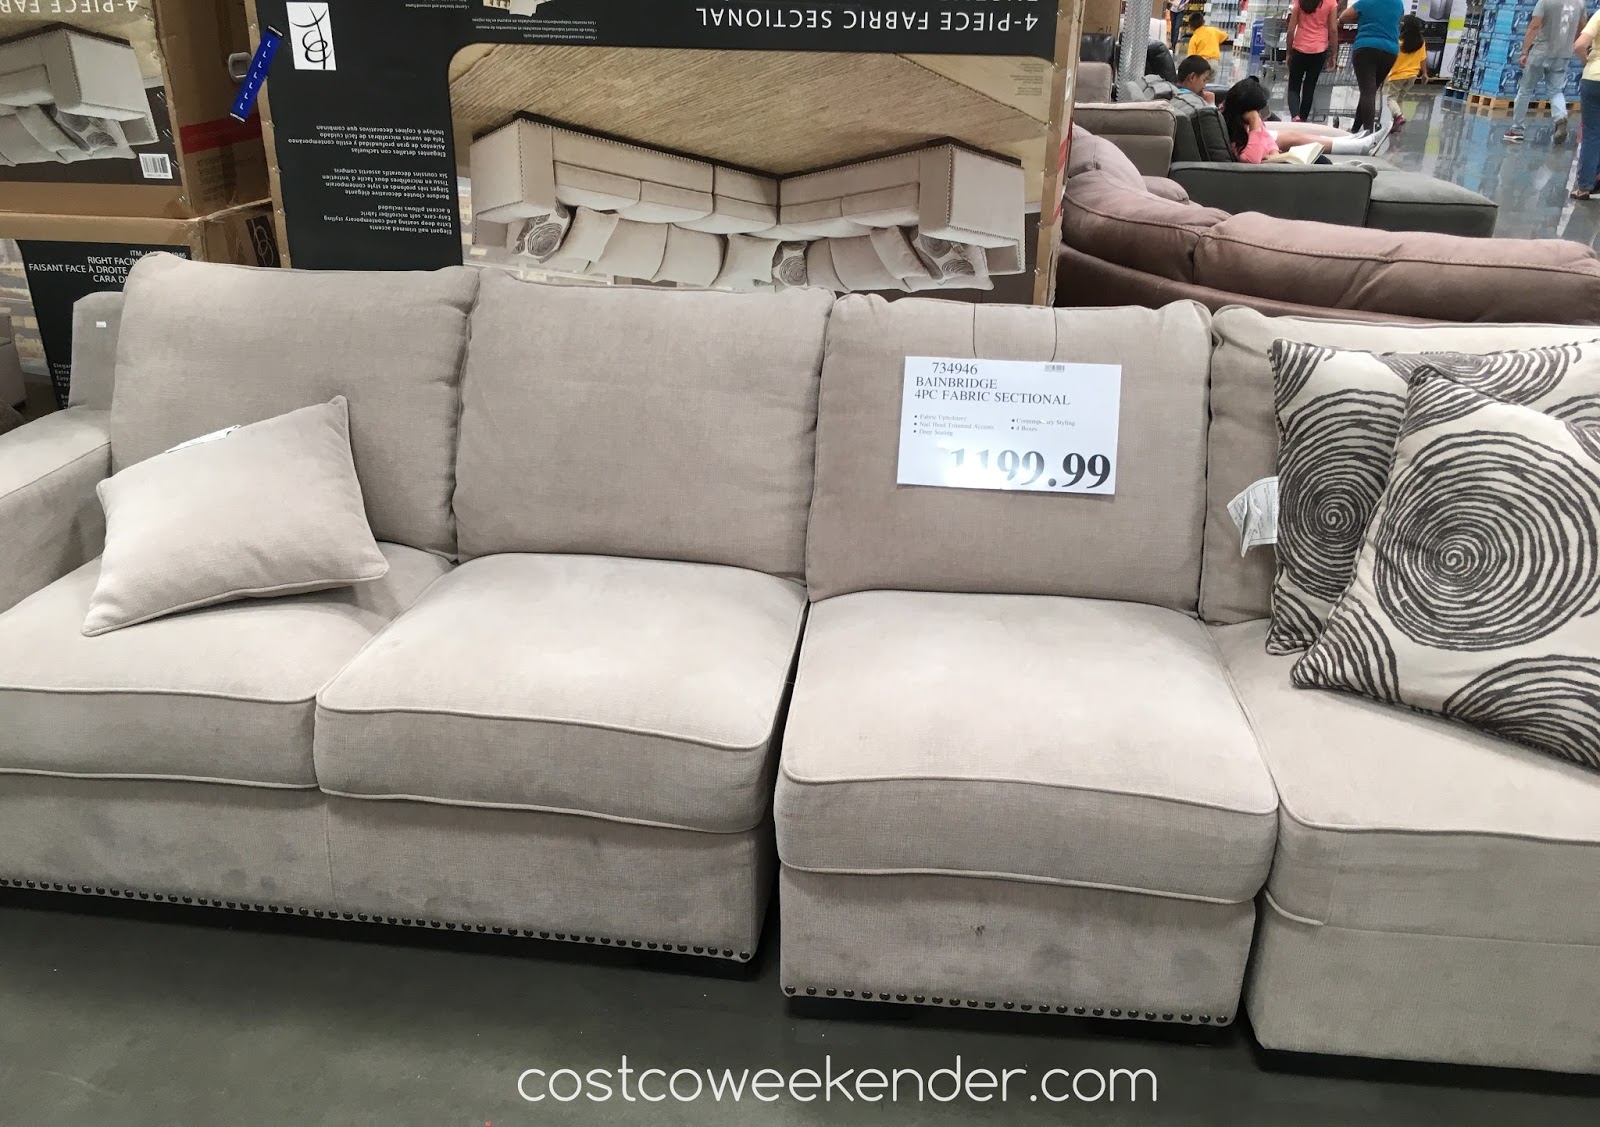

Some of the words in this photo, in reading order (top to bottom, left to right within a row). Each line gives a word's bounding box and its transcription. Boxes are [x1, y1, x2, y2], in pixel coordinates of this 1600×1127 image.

[696, 8, 832, 28] SECTIONAL
[843, 10, 929, 30] FABRIC
[940, 12, 1038, 31] 4-PIECE
[87, 256, 112, 265] RIGHT
[29, 263, 63, 272] FAISANT
[65, 264, 86, 273] FACE
[95, 265, 128, 275] DROITE
[93, 274, 117, 283] CARA
[932, 361, 979, 375] 734946
[916, 376, 998, 389] BAINBRIDGE
[914, 389, 938, 399] 4PC
[942, 390, 990, 402] FABRIC
[994, 392, 1071, 405] SECTIONAL
